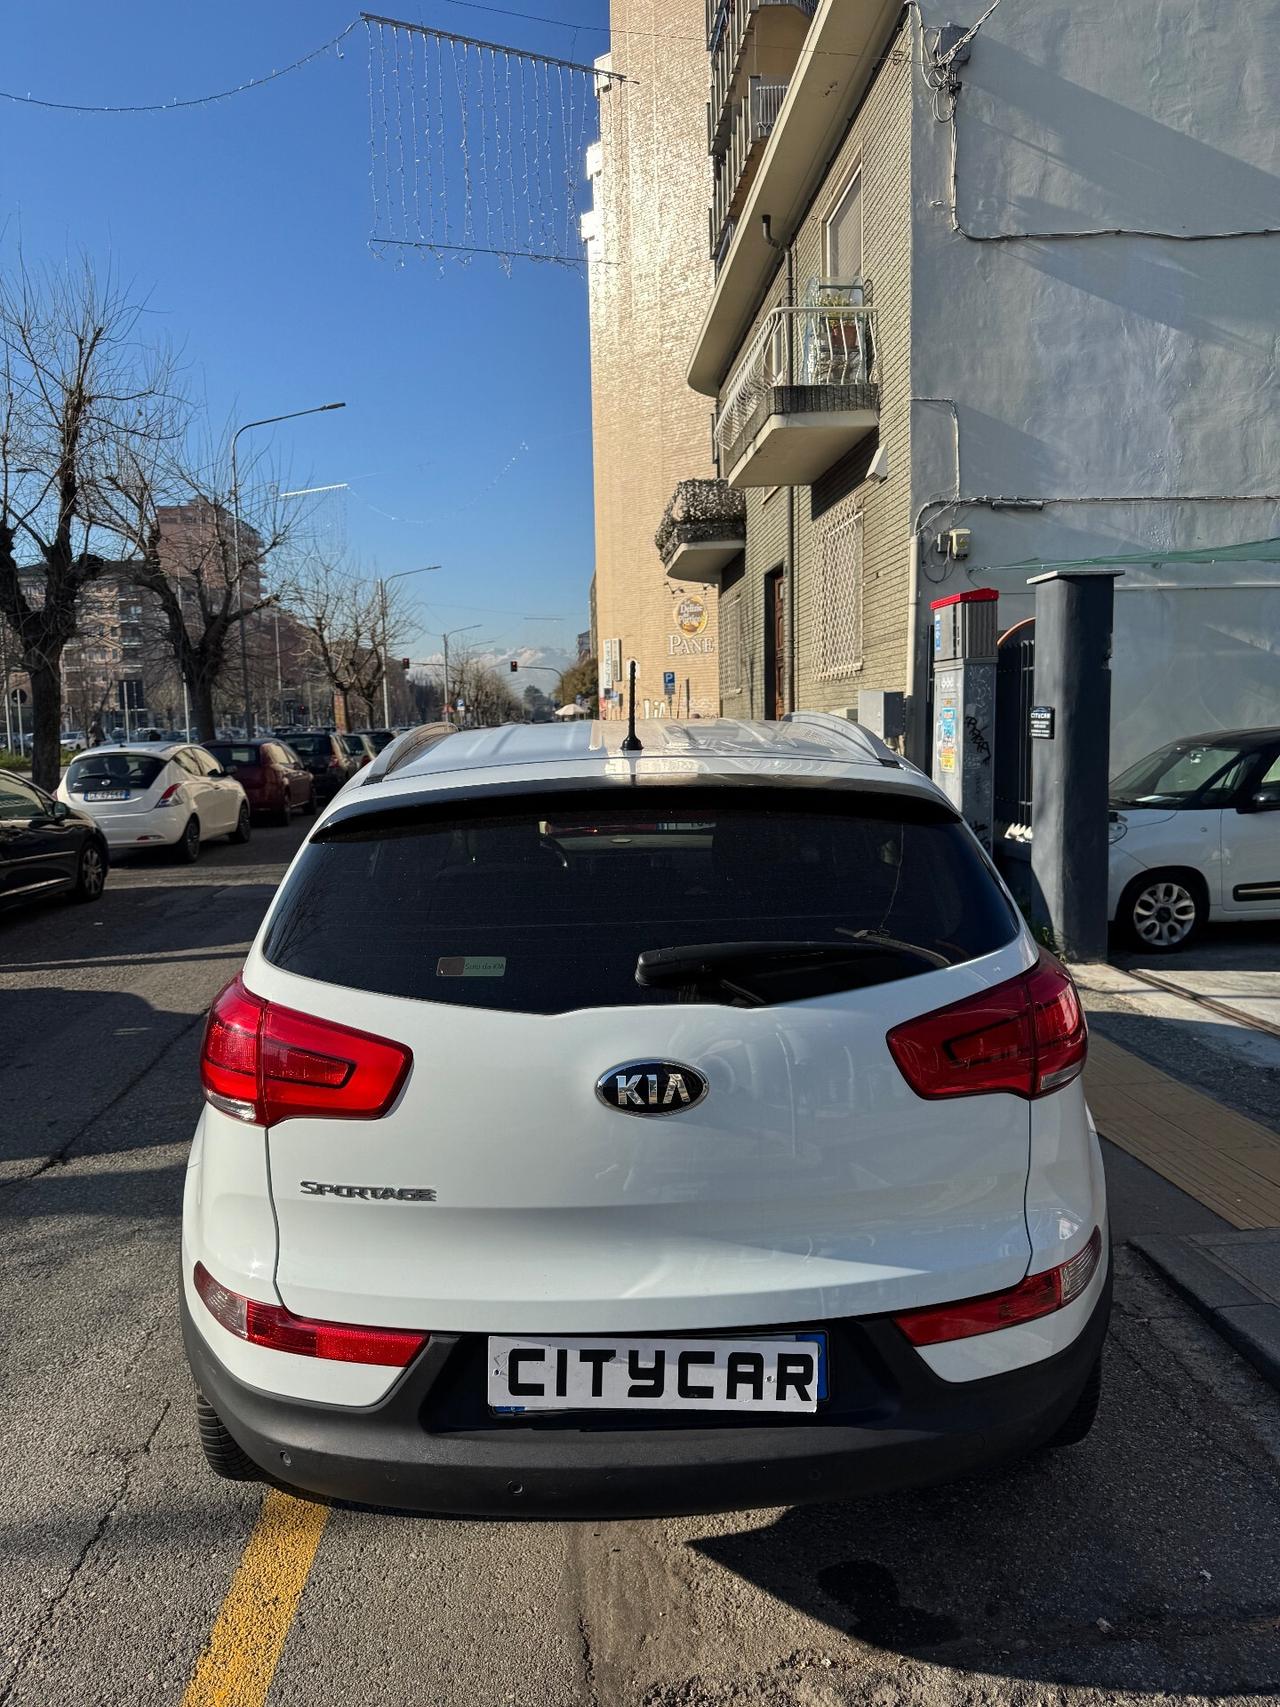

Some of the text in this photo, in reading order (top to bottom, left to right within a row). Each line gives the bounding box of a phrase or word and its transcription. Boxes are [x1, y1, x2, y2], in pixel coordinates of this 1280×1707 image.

[669, 635, 714, 656] PANE
[615, 1073, 691, 1105] KIA
[300, 1180, 438, 1202] SPORTAGE
[507, 1347, 816, 1402] CITYCAR
